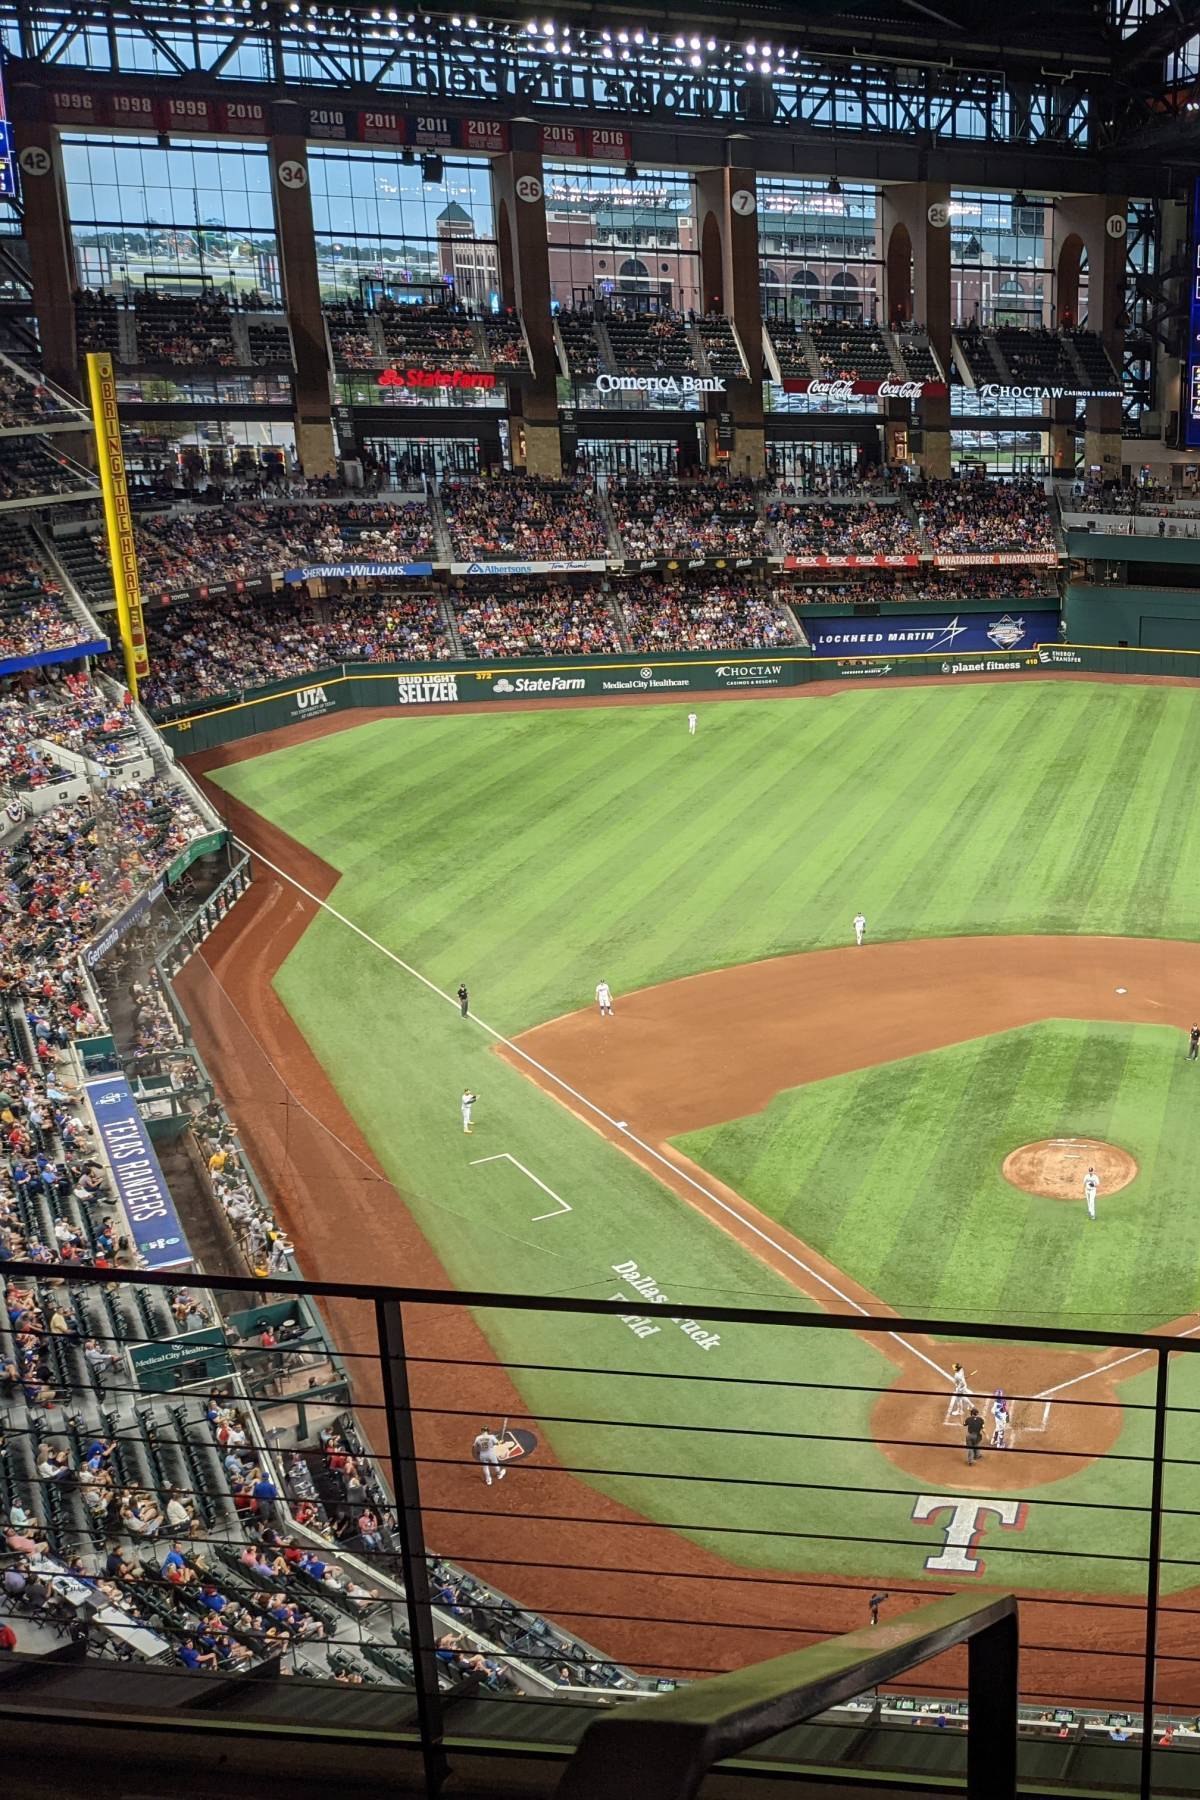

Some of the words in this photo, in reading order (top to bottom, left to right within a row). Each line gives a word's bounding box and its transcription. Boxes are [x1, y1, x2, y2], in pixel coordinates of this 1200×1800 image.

[54, 94, 92, 109] 1996
[112, 96, 152, 112] 1998
[169, 100, 208, 116] 1999
[226, 103, 262, 119] 2010
[310, 110, 344, 125] 2010
[364, 114, 397, 129] 2011
[416, 117, 448, 132] 2011
[468, 121, 502, 136] 2012
[543, 126, 574, 142] 2015
[592, 130, 624, 146] 2016
[23, 152, 46, 169] 42
[282, 166, 304, 183] 34
[519, 181, 540, 196] 26
[738, 197, 749, 210] 7
[930, 208, 946, 222] 29
[1110, 220, 1122, 234] 10
[681, 376, 727, 392] Bank
[807, 380, 856, 399] Coca-Cola
[878, 380, 925, 398] Coca-Cola
[988, 383, 1064, 399] CHOCTAW
[484, 564, 532, 574] Albertsons
[551, 562, 565, 571] Tom
[566, 560, 592, 571] Thumb
[796, 556, 818, 564] DEX
[826, 556, 848, 564] DEX
[937, 554, 995, 566] WHATABURGER
[998, 554, 1056, 565] WHATABURGER
[171, 592, 190, 601] TOYOTA
[208, 586, 228, 595] TOYOTA
[244, 579, 262, 588] TOYOTA
[819, 632, 884, 644] LOCKHEED
[888, 632, 935, 642] MARTIN
[721, 664, 782, 677] CHOCTAW
[952, 662, 984, 674] planet
[986, 660, 1021, 672] fitness
[398, 676, 422, 685] BUD
[423, 674, 456, 684] LIGHT
[515, 677, 549, 692] State
[550, 677, 585, 690] Farm
[602, 680, 633, 690] Medical
[632, 679, 650, 690] City
[649, 678, 690, 688] Healthcare
[296, 687, 328, 709] UTA
[398, 682, 459, 704] SELTZER
[104, 1117, 146, 1160] TEXAS
[116, 1159, 168, 1222] RANGERS
[911, 1494, 1027, 1578] T
